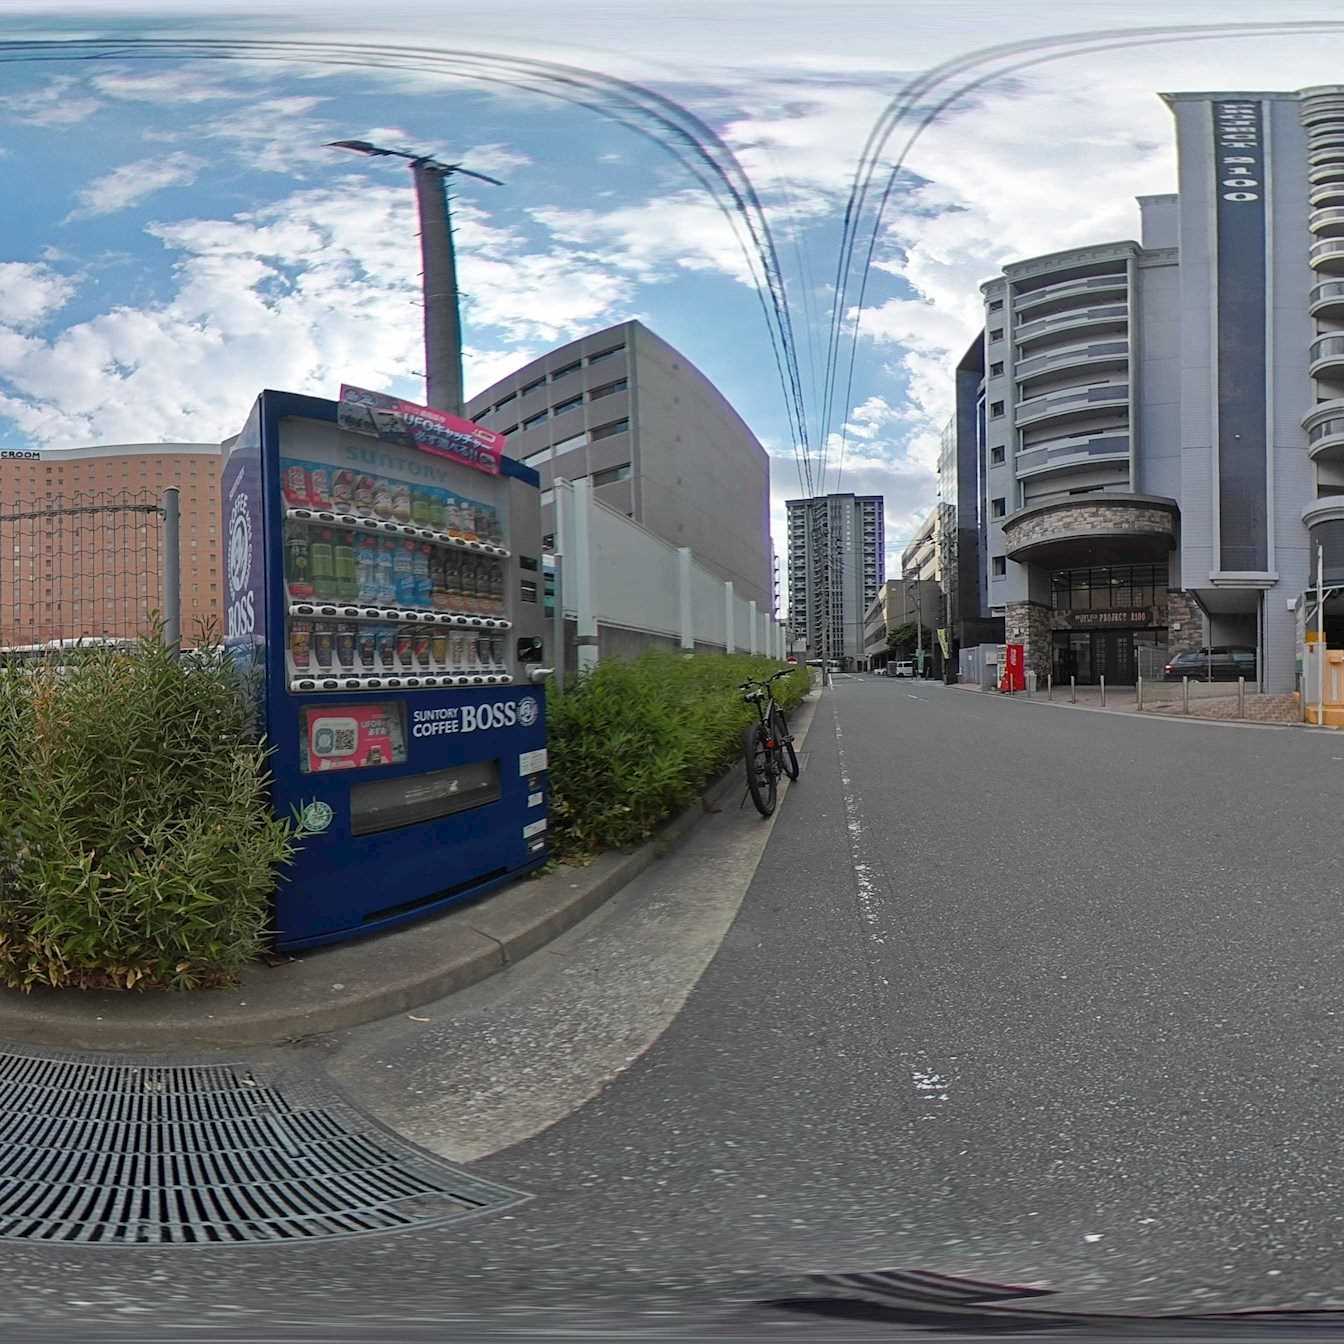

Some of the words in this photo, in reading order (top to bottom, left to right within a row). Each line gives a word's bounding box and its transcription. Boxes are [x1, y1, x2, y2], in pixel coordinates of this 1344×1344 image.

[1222, 156, 1258, 201] 2100
[1, 451, 41, 459] CROOM
[228, 590, 255, 638] BOSS
[413, 707, 459, 722] SUNTORY
[460, 701, 517, 733] BOSS
[412, 720, 459, 737] COFFEE
